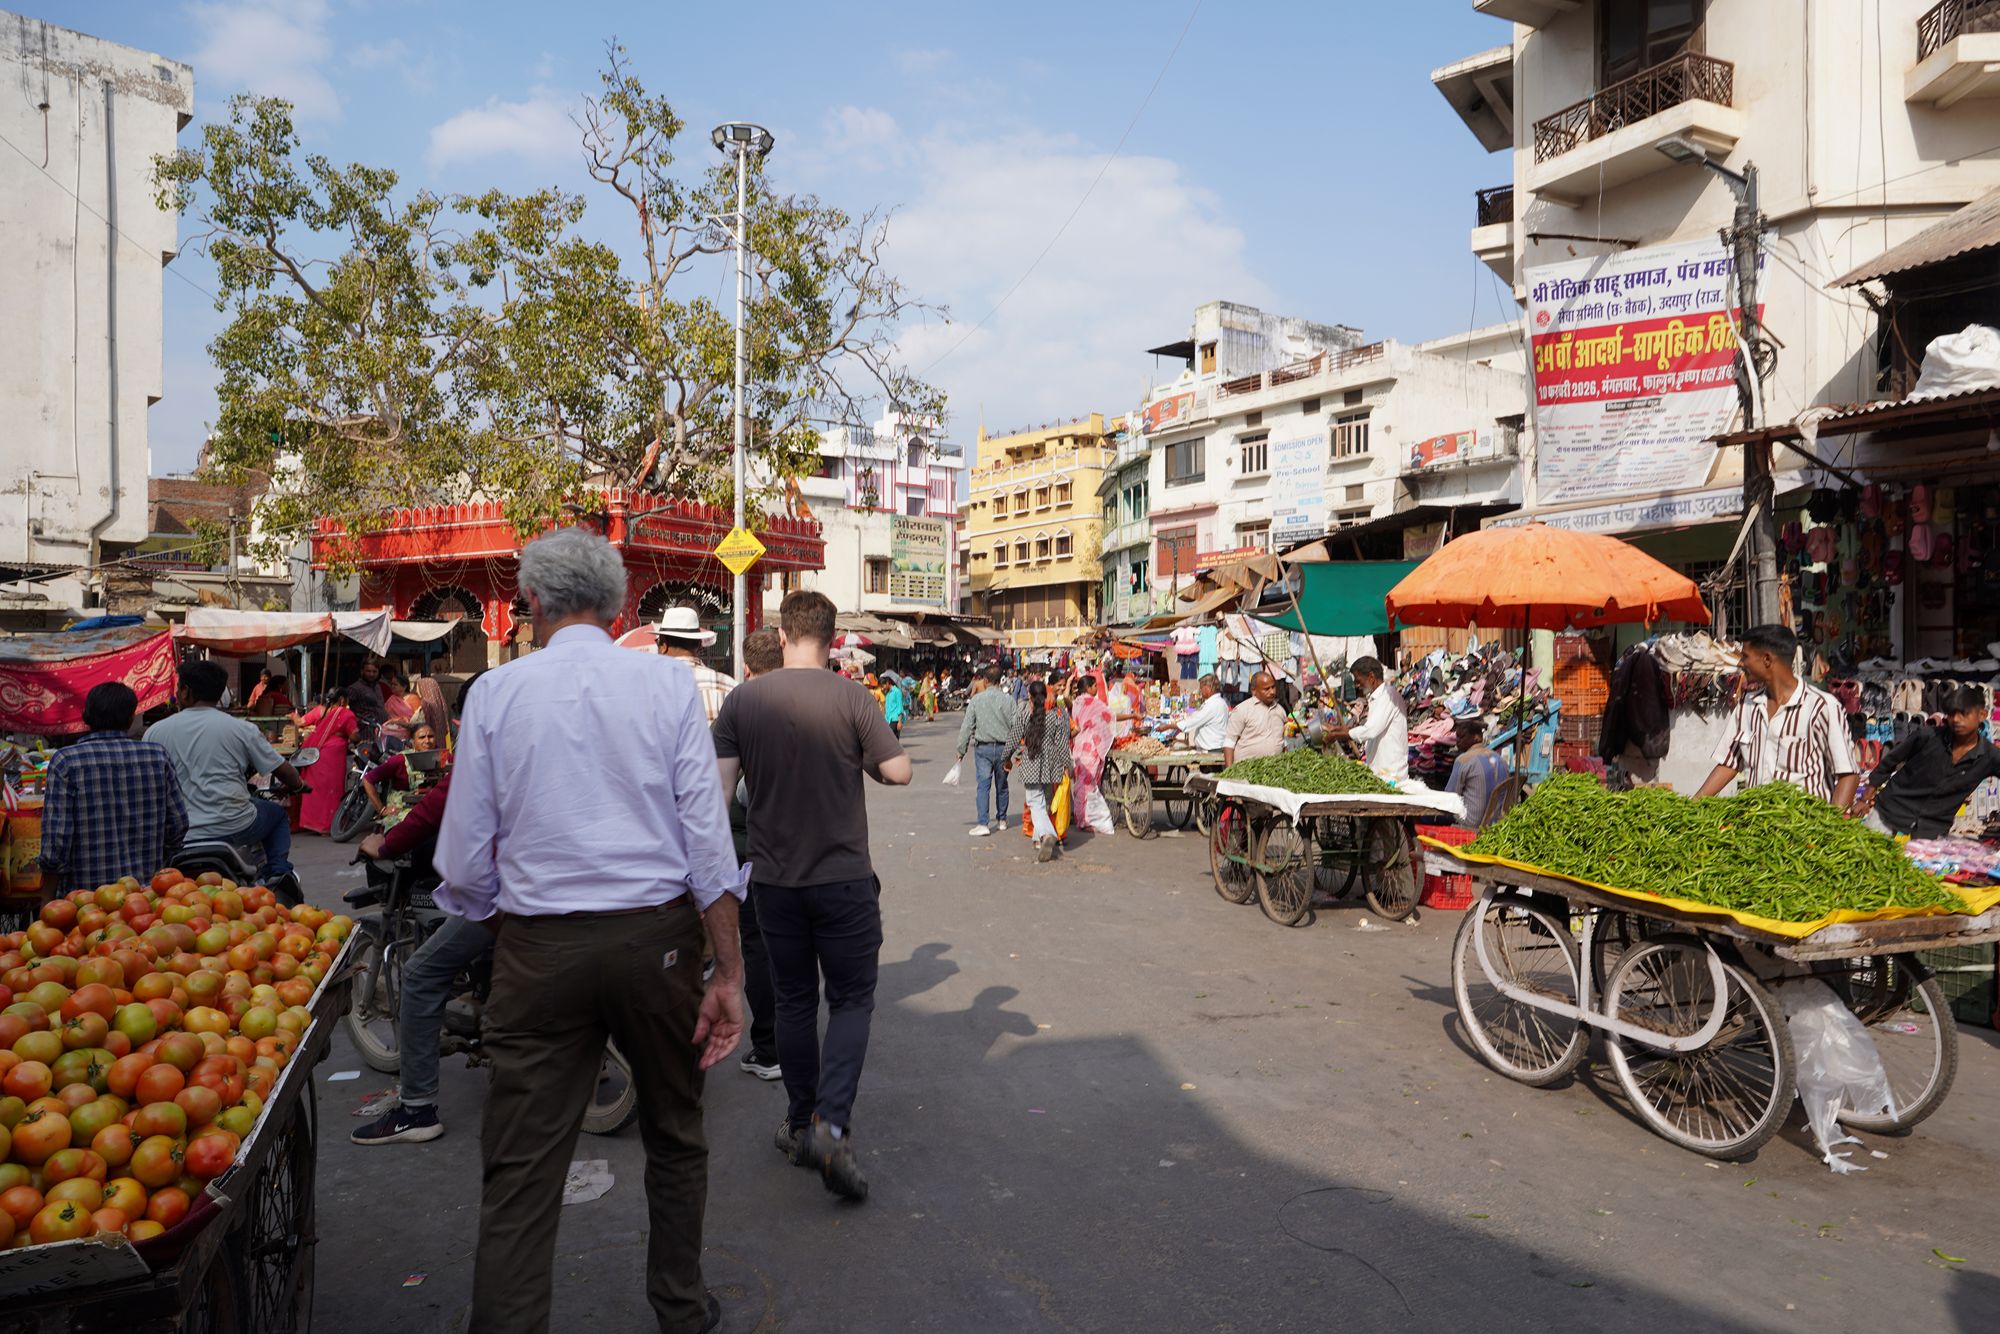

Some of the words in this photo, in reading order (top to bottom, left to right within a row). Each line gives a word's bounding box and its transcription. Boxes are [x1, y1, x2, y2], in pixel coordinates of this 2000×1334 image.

[1533, 282, 1548, 302] श्री
[1594, 275, 1622, 297] साहू
[1624, 267, 1672, 290] समाज,
[1677, 258, 1701, 281] पंच
[1558, 308, 1574, 324] सेवा
[1576, 304, 1604, 322] समिति
[1659, 293, 1693, 312] उदयपुर
[1572, 380, 1600, 398] 2026,
[1274, 439, 1305, 451] ADMISSION
[1306, 435, 1323, 446] OPEN
[1276, 464, 1320, 477] Pre-School
[1615, 505, 1635, 523] पंच
[411, 893, 431, 901] HERO
